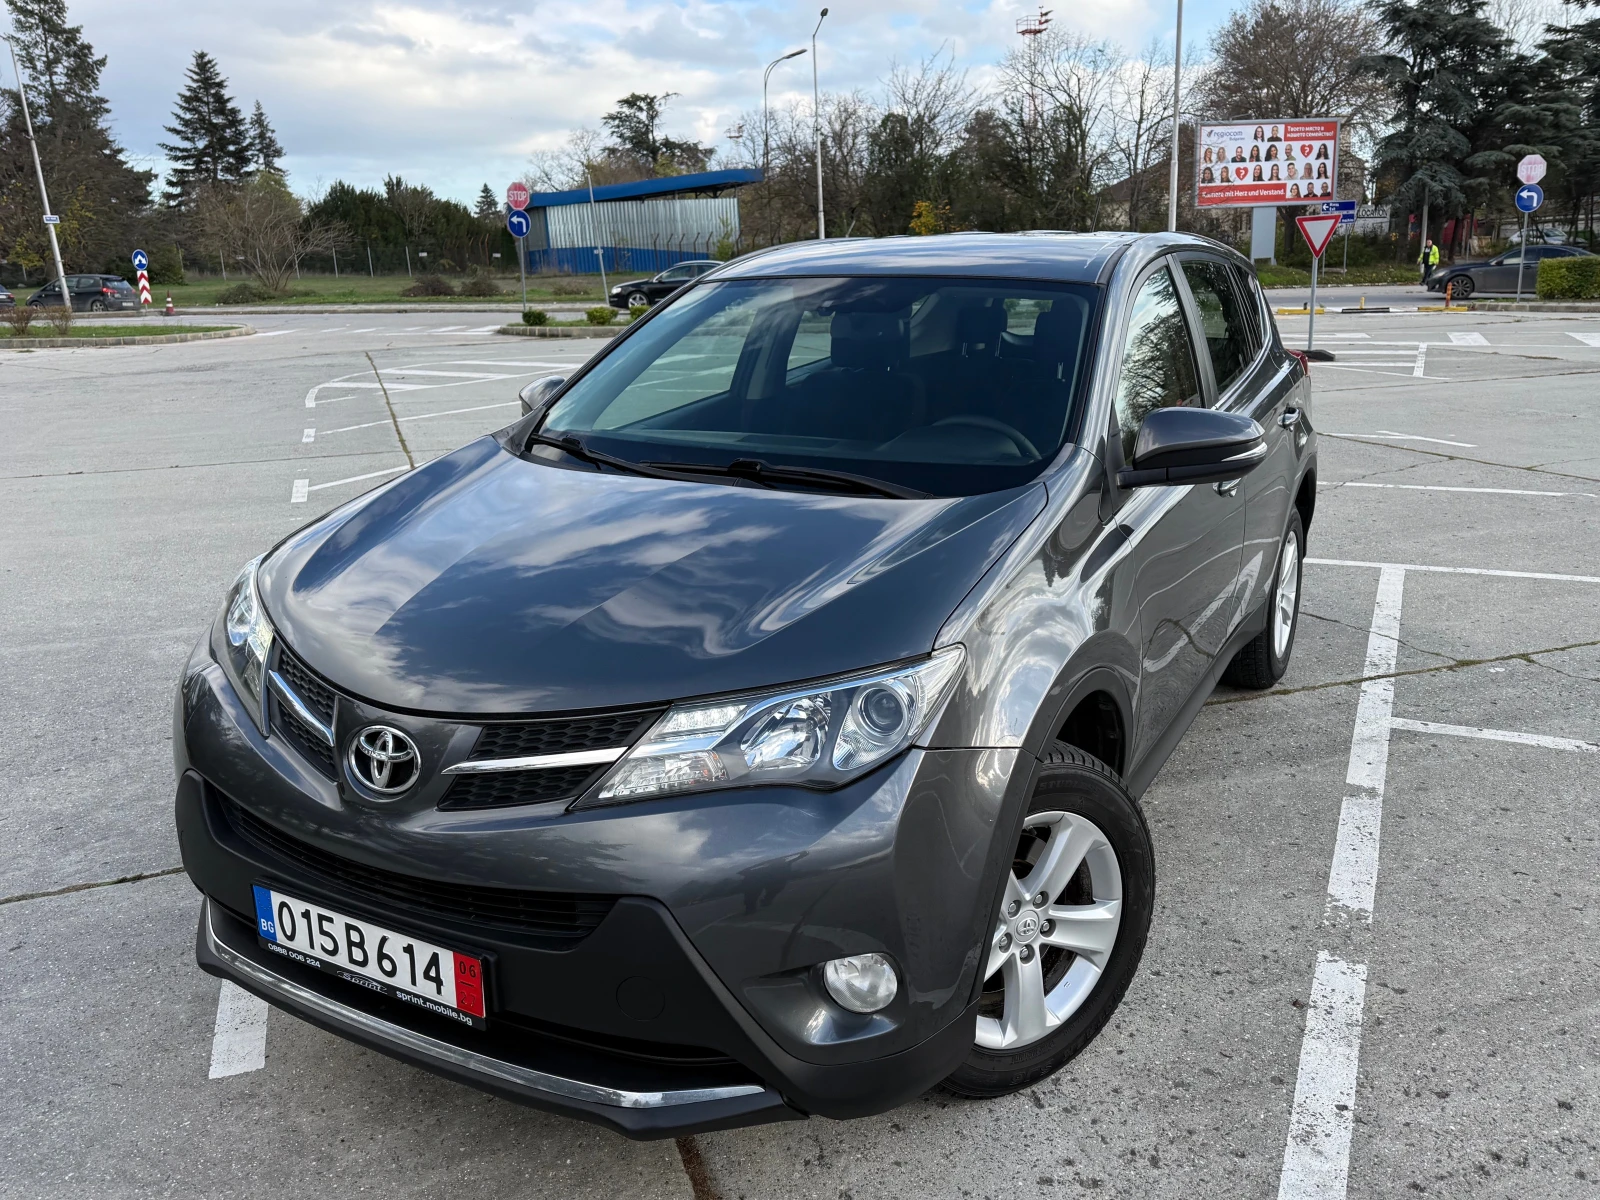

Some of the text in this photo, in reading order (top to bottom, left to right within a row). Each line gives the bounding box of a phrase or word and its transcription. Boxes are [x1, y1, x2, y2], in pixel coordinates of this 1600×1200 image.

[1521, 164, 1544, 174] STOP
[508, 191, 527, 201] STOP
[260, 918, 275, 933] BG
[277, 900, 444, 996] 015B614
[459, 961, 476, 978] 06
[396, 991, 473, 1026] sprint.mobile.bg
